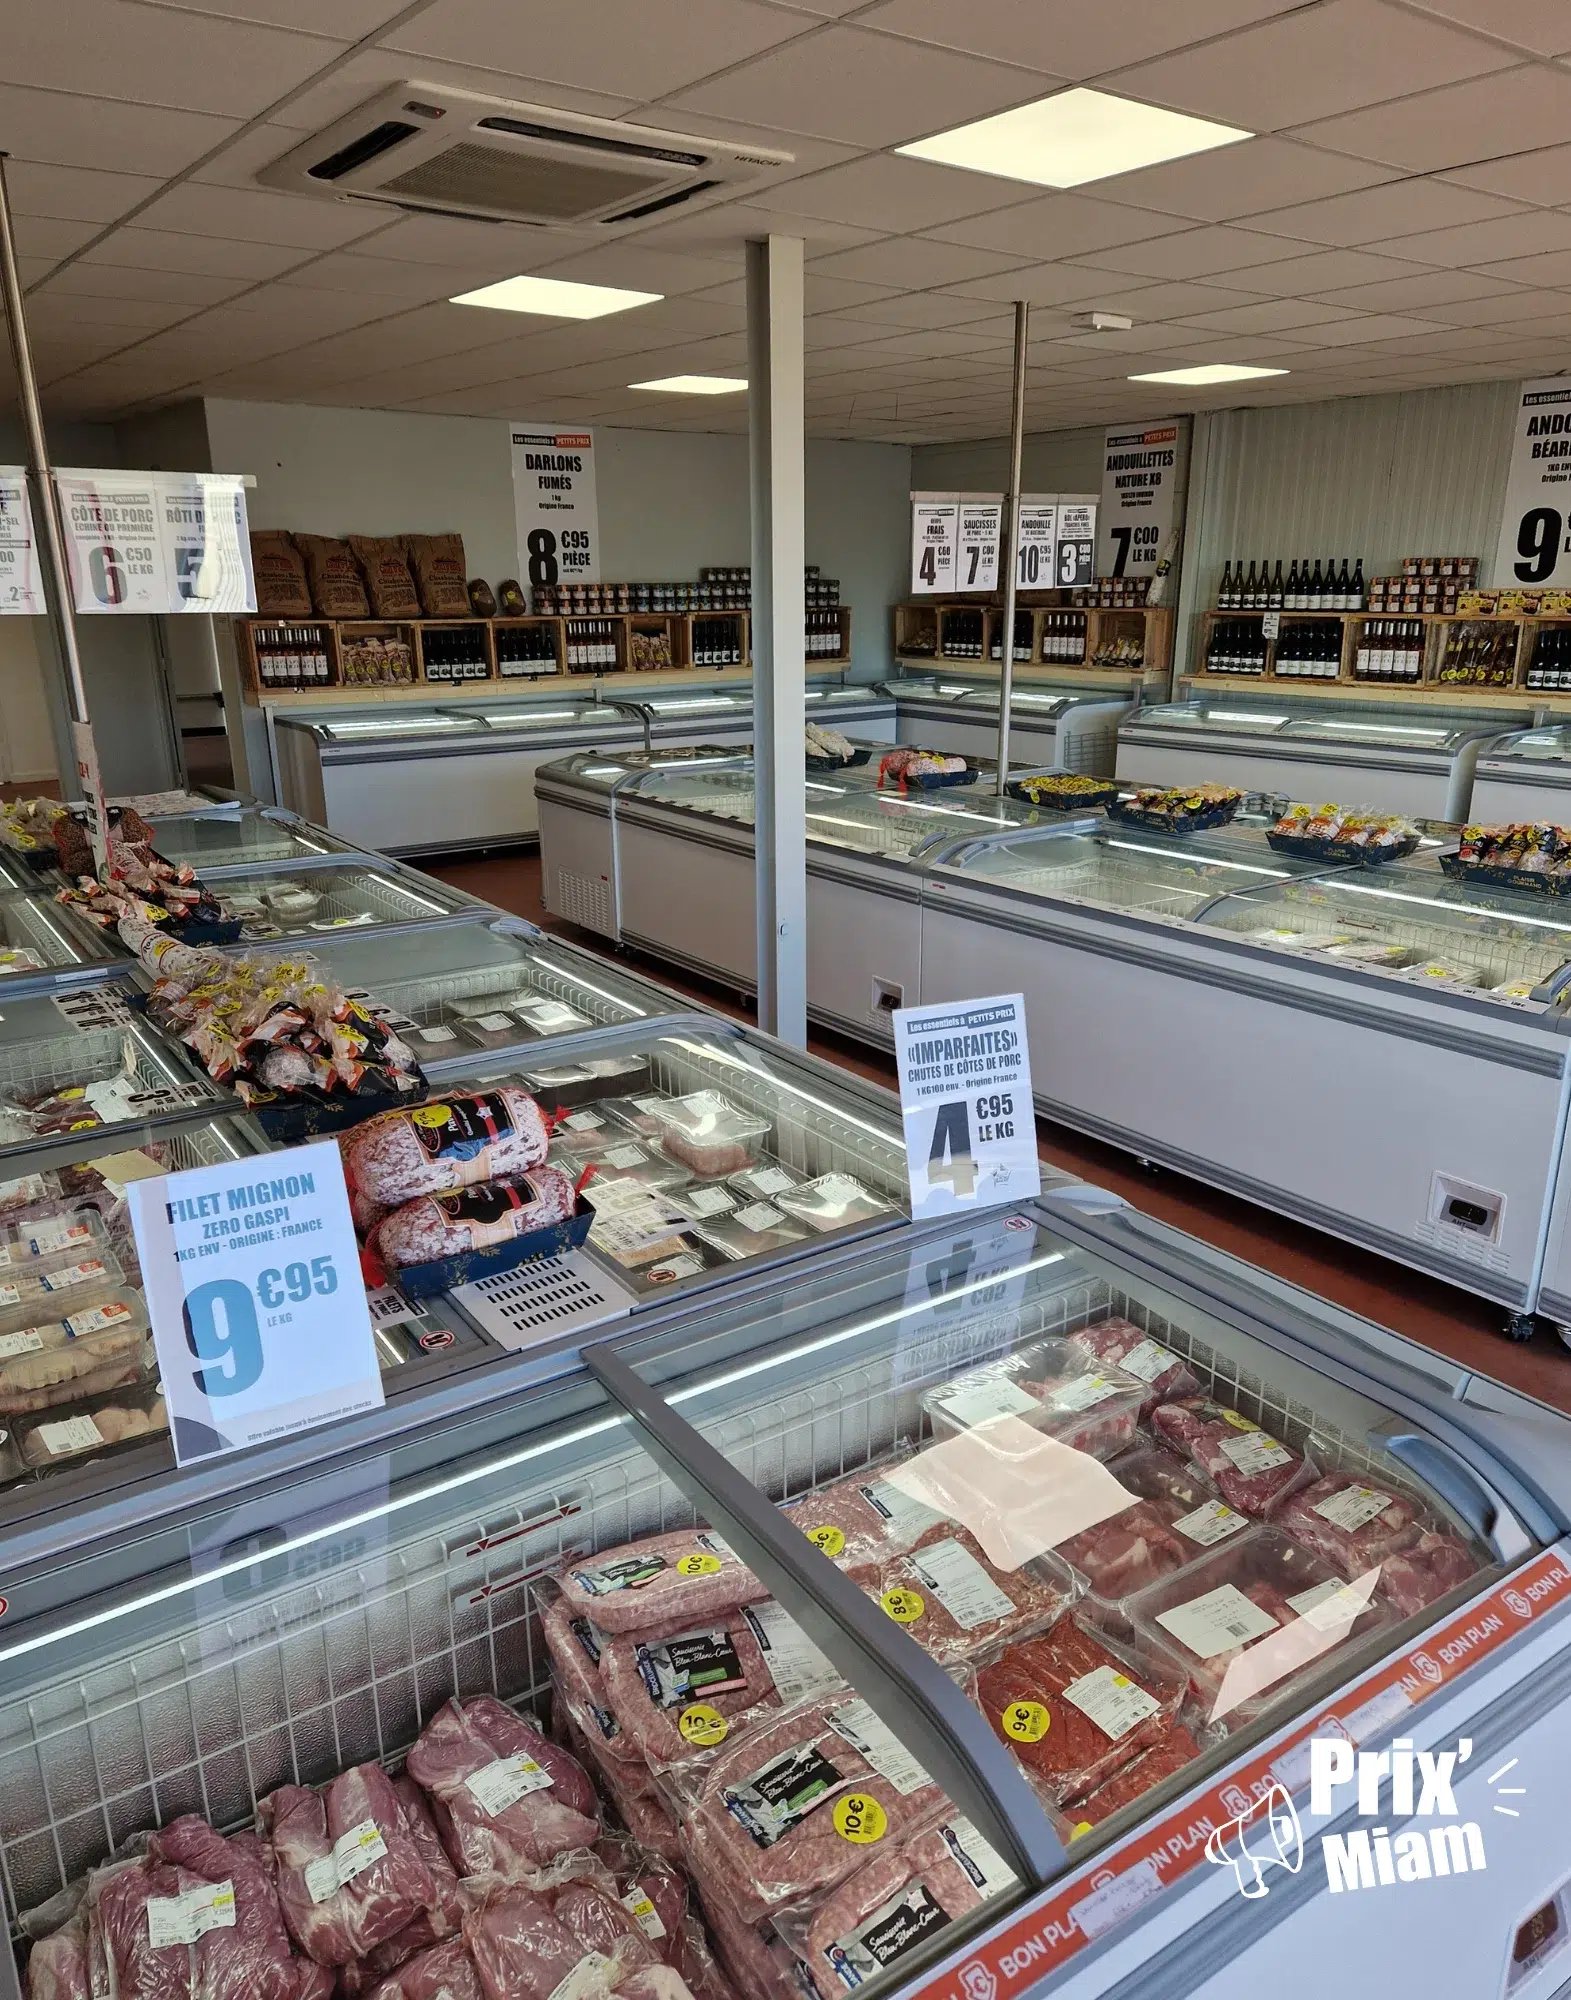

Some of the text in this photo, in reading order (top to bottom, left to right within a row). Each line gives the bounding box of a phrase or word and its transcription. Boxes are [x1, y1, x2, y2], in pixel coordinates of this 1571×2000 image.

[1526, 395, 1538, 404] Les
[514, 435, 523, 443] Les
[523, 436, 550, 445] essentiels
[557, 436, 575, 446] PETITS
[576, 436, 590, 446] PRIX
[1145, 432, 1162, 441] PETITS
[1163, 430, 1176, 438] PRIX
[525, 453, 582, 472] DARLONS
[1106, 449, 1174, 471] ANDOUILLETTES
[1547, 464, 1560, 472] 1KG
[538, 474, 572, 490] FUMÉS
[1115, 472, 1162, 488] NATURE X8
[1541, 473, 1567, 483] Origine
[71, 502, 153, 522] CÔTE DE PORC
[166, 505, 194, 523] RÔTI
[539, 502, 557, 510] Origine
[117, 521, 153, 532] PREMIÈRE
[927, 525, 945, 535] FRAIS
[963, 519, 997, 529] SAUCISSES
[1021, 519, 1051, 529] ANDOUILLE
[1111, 526, 1159, 578] 7 €00
[1513, 507, 1562, 583] 9
[527, 529, 589, 587] 8 €95
[562, 550, 590, 566] PIÈCE
[937, 556, 951, 566] PIÈCE
[966, 545, 980, 585] 7
[982, 556, 994, 565] LE KG
[1018, 544, 1051, 583] 10 €95
[1061, 543, 1077, 582] 3
[1133, 549, 1156, 562] LE KG
[88, 546, 152, 604] 6 €50
[127, 564, 153, 575] LE KG
[919, 546, 936, 586] 4
[910, 1006, 1015, 1033] Les essentiels à PETITS PRIX
[908, 1053, 1021, 1083] CHUTES DE CÔTES DE PORC
[944, 1080, 961, 1091] env.
[965, 1075, 992, 1089] Origine
[993, 1072, 1018, 1085] France
[978, 1120, 1015, 1142] LE KG
[927, 1093, 1014, 1197] 4 €95
[165, 1172, 316, 1225] FILET MIGNON
[202, 1205, 290, 1240] ZERO GASPI
[173, 1217, 323, 1263] 1KG ENV ORIGINE FRANCE
[382, 1295, 405, 1314] FILETS
[181, 1254, 339, 1398] 9 €95
[267, 1312, 293, 1328] LE KG
[248, 1432, 263, 1442] Offre
[263, 1424, 285, 1438] valable
[307, 1409, 342, 1425] épuisement
[342, 1406, 353, 1415] des
[353, 1400, 372, 1412] stocks
[813, 1532, 829, 1549] 8€
[687, 1556, 703, 1575] 10€
[1524, 1575, 1558, 1602] BON
[889, 1595, 907, 1616] 8€
[1437, 1613, 1504, 1664] BON PLAN
[1012, 1708, 1030, 1732] 9€
[844, 1798, 865, 1837] 10€
[1165, 1815, 1216, 1857] PLAN
[997, 1934, 1048, 1979] BON
